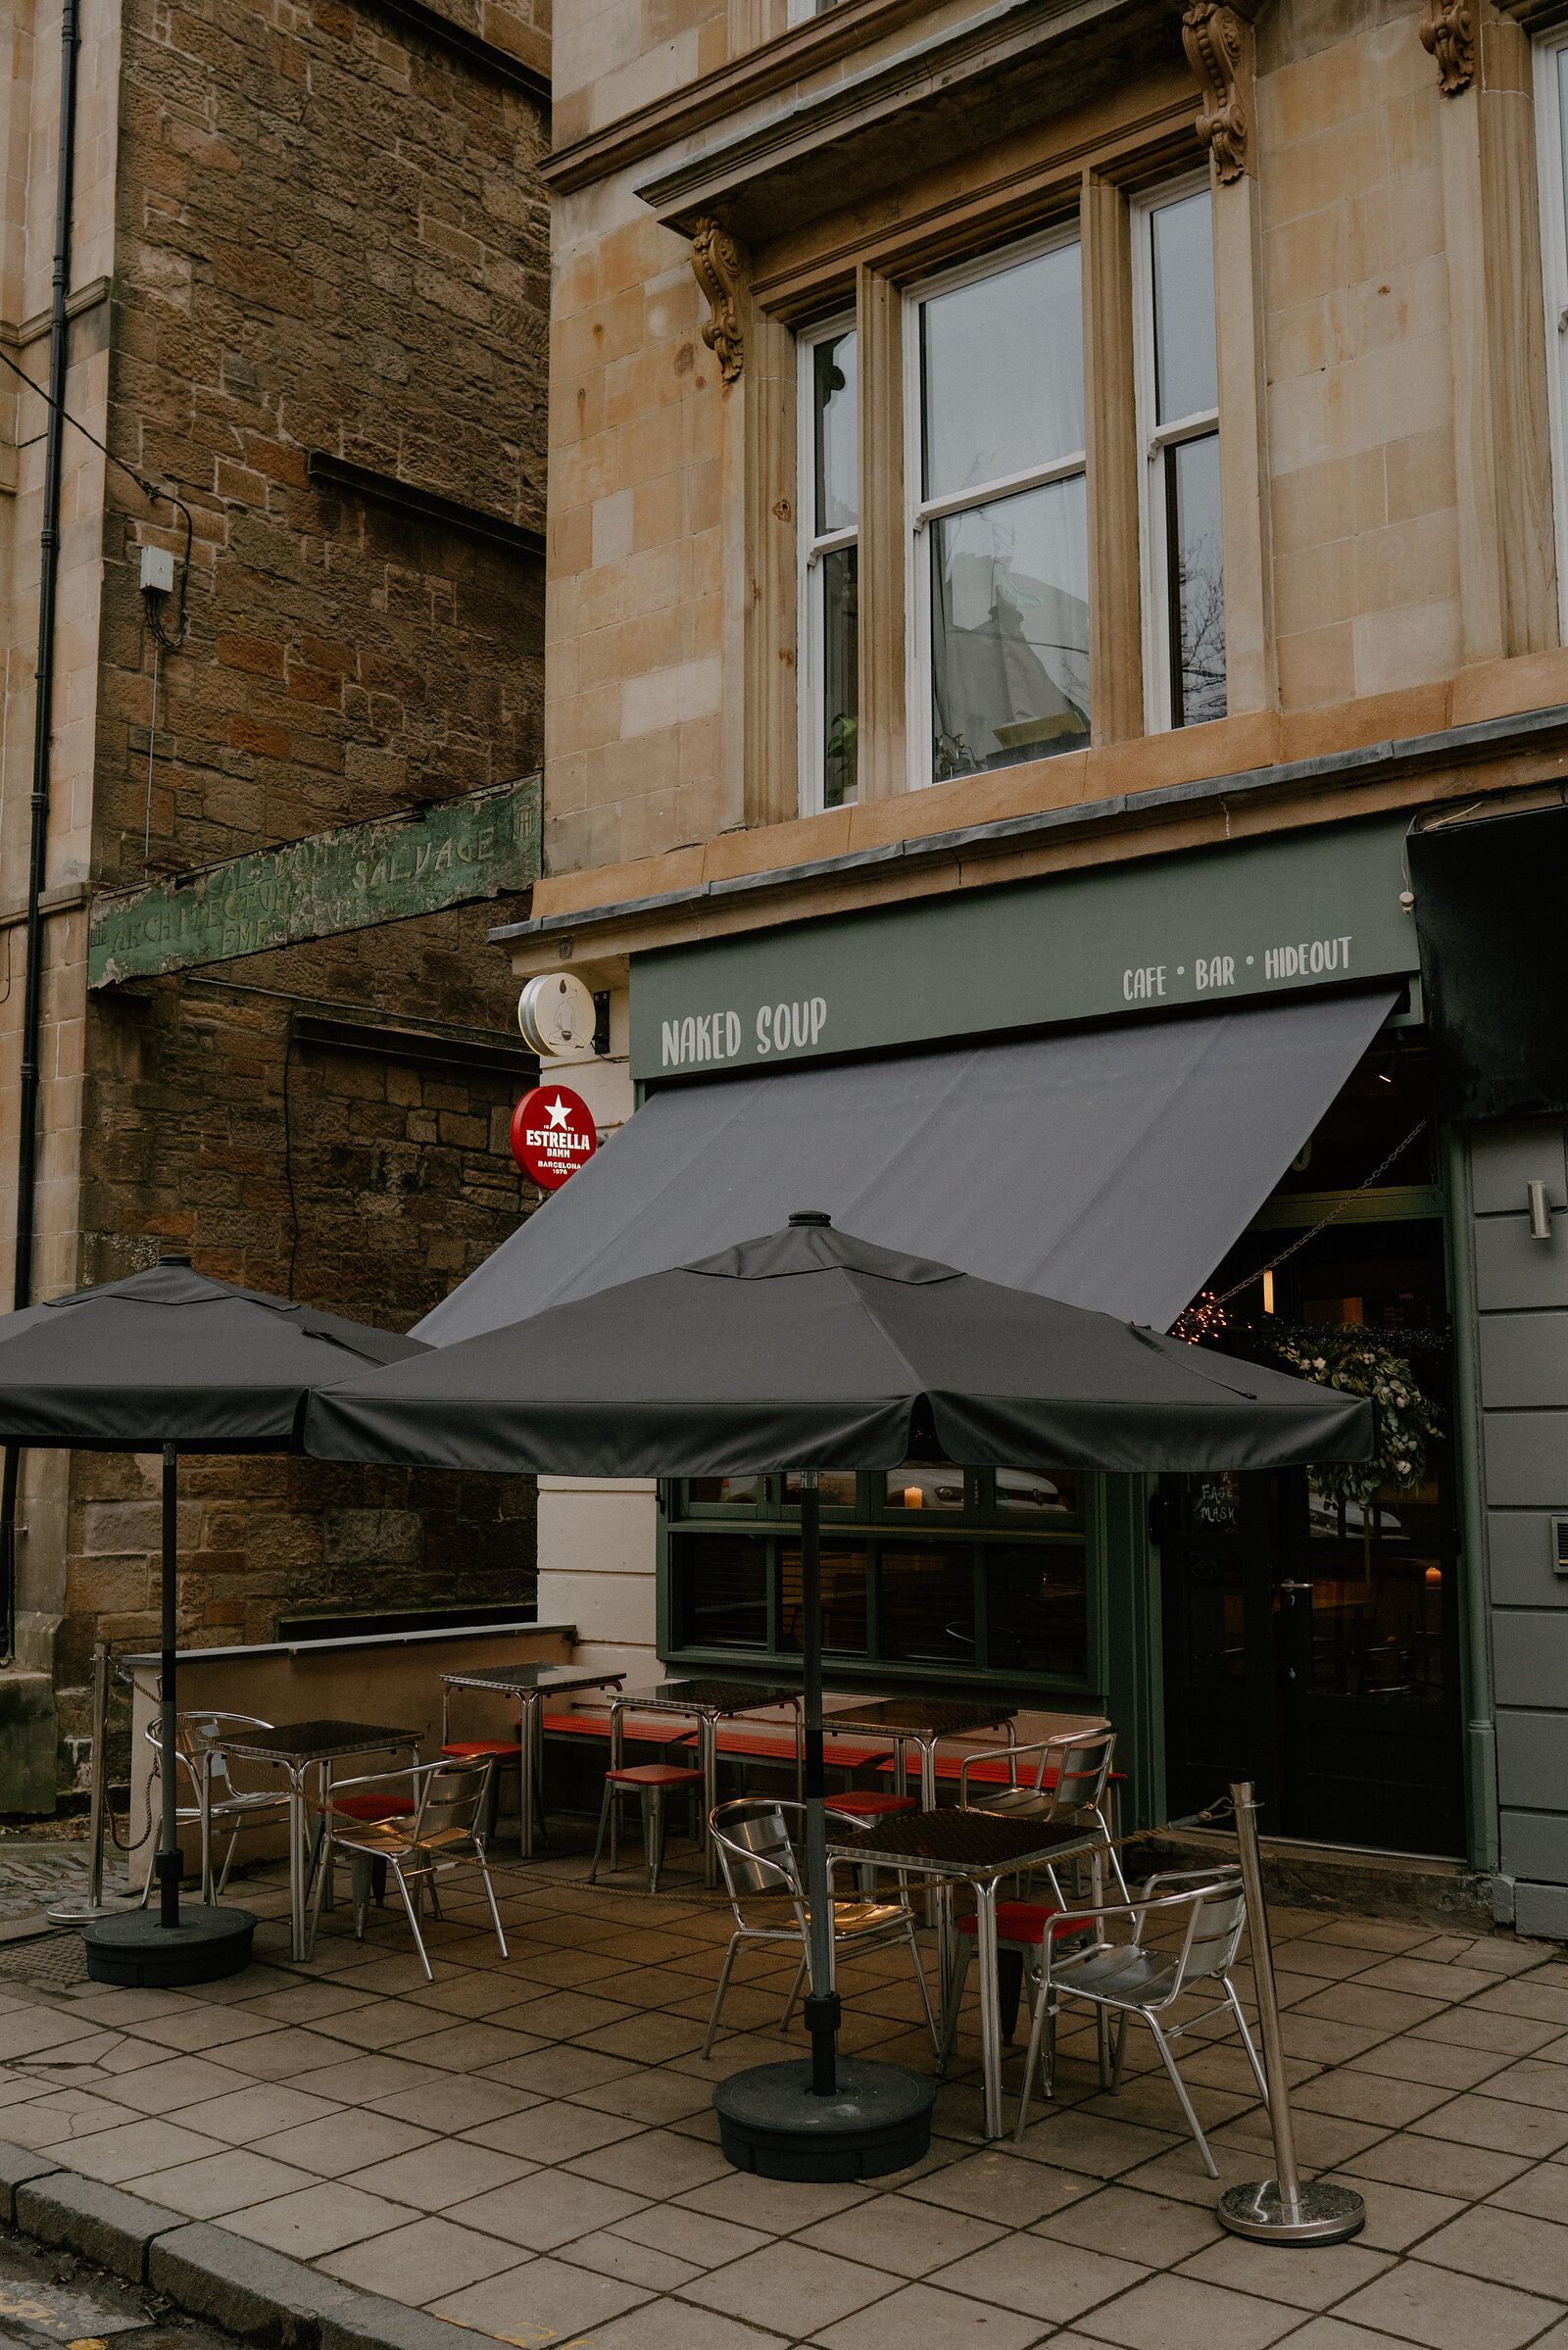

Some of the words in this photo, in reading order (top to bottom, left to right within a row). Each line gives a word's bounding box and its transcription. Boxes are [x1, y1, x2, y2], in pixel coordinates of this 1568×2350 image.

[351, 827, 495, 890] SALVAGE
[1123, 966, 1167, 1000] CAFE
[1196, 955, 1235, 991] BAR
[1265, 936, 1352, 979] HIDEOUT
[662, 1010, 741, 1066] NAKED
[757, 997, 827, 1054] SOUP
[525, 1129, 591, 1151] ESTRELLA
[546, 1148, 570, 1158] DAMM
[537, 1159, 581, 1169] BARCELONA
[1201, 1484, 1234, 1504] FACE
[1200, 1506, 1238, 1526] MASK
